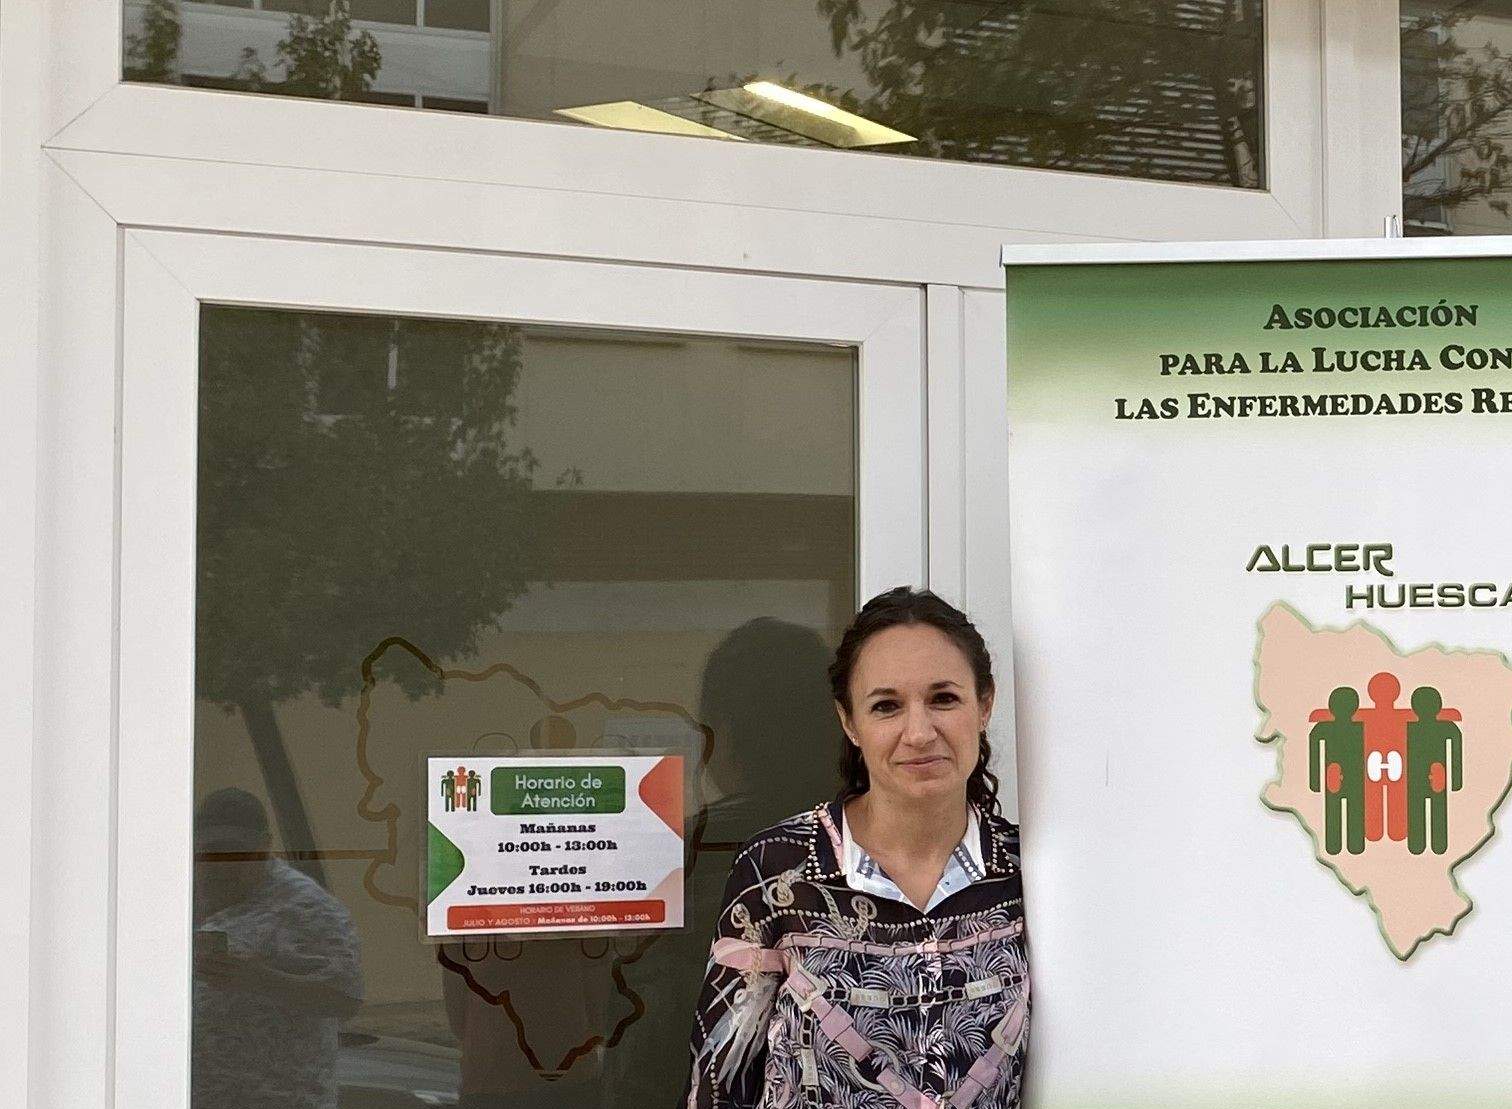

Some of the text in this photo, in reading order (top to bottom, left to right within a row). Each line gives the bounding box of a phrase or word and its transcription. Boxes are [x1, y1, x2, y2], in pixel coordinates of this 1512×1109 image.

[1245, 543, 1395, 577] ALCER
[515, 772, 603, 790] Horario de
[520, 793, 597, 809] Atención
[519, 822, 597, 834] Mañanas
[497, 841, 552, 853] 10:00h
[564, 839, 618, 851] 13:00h
[528, 864, 587, 876] Tardes
[466, 884, 526, 896] Jueves
[528, 882, 582, 894] 16:00h
[594, 880, 648, 892] 19:00h
